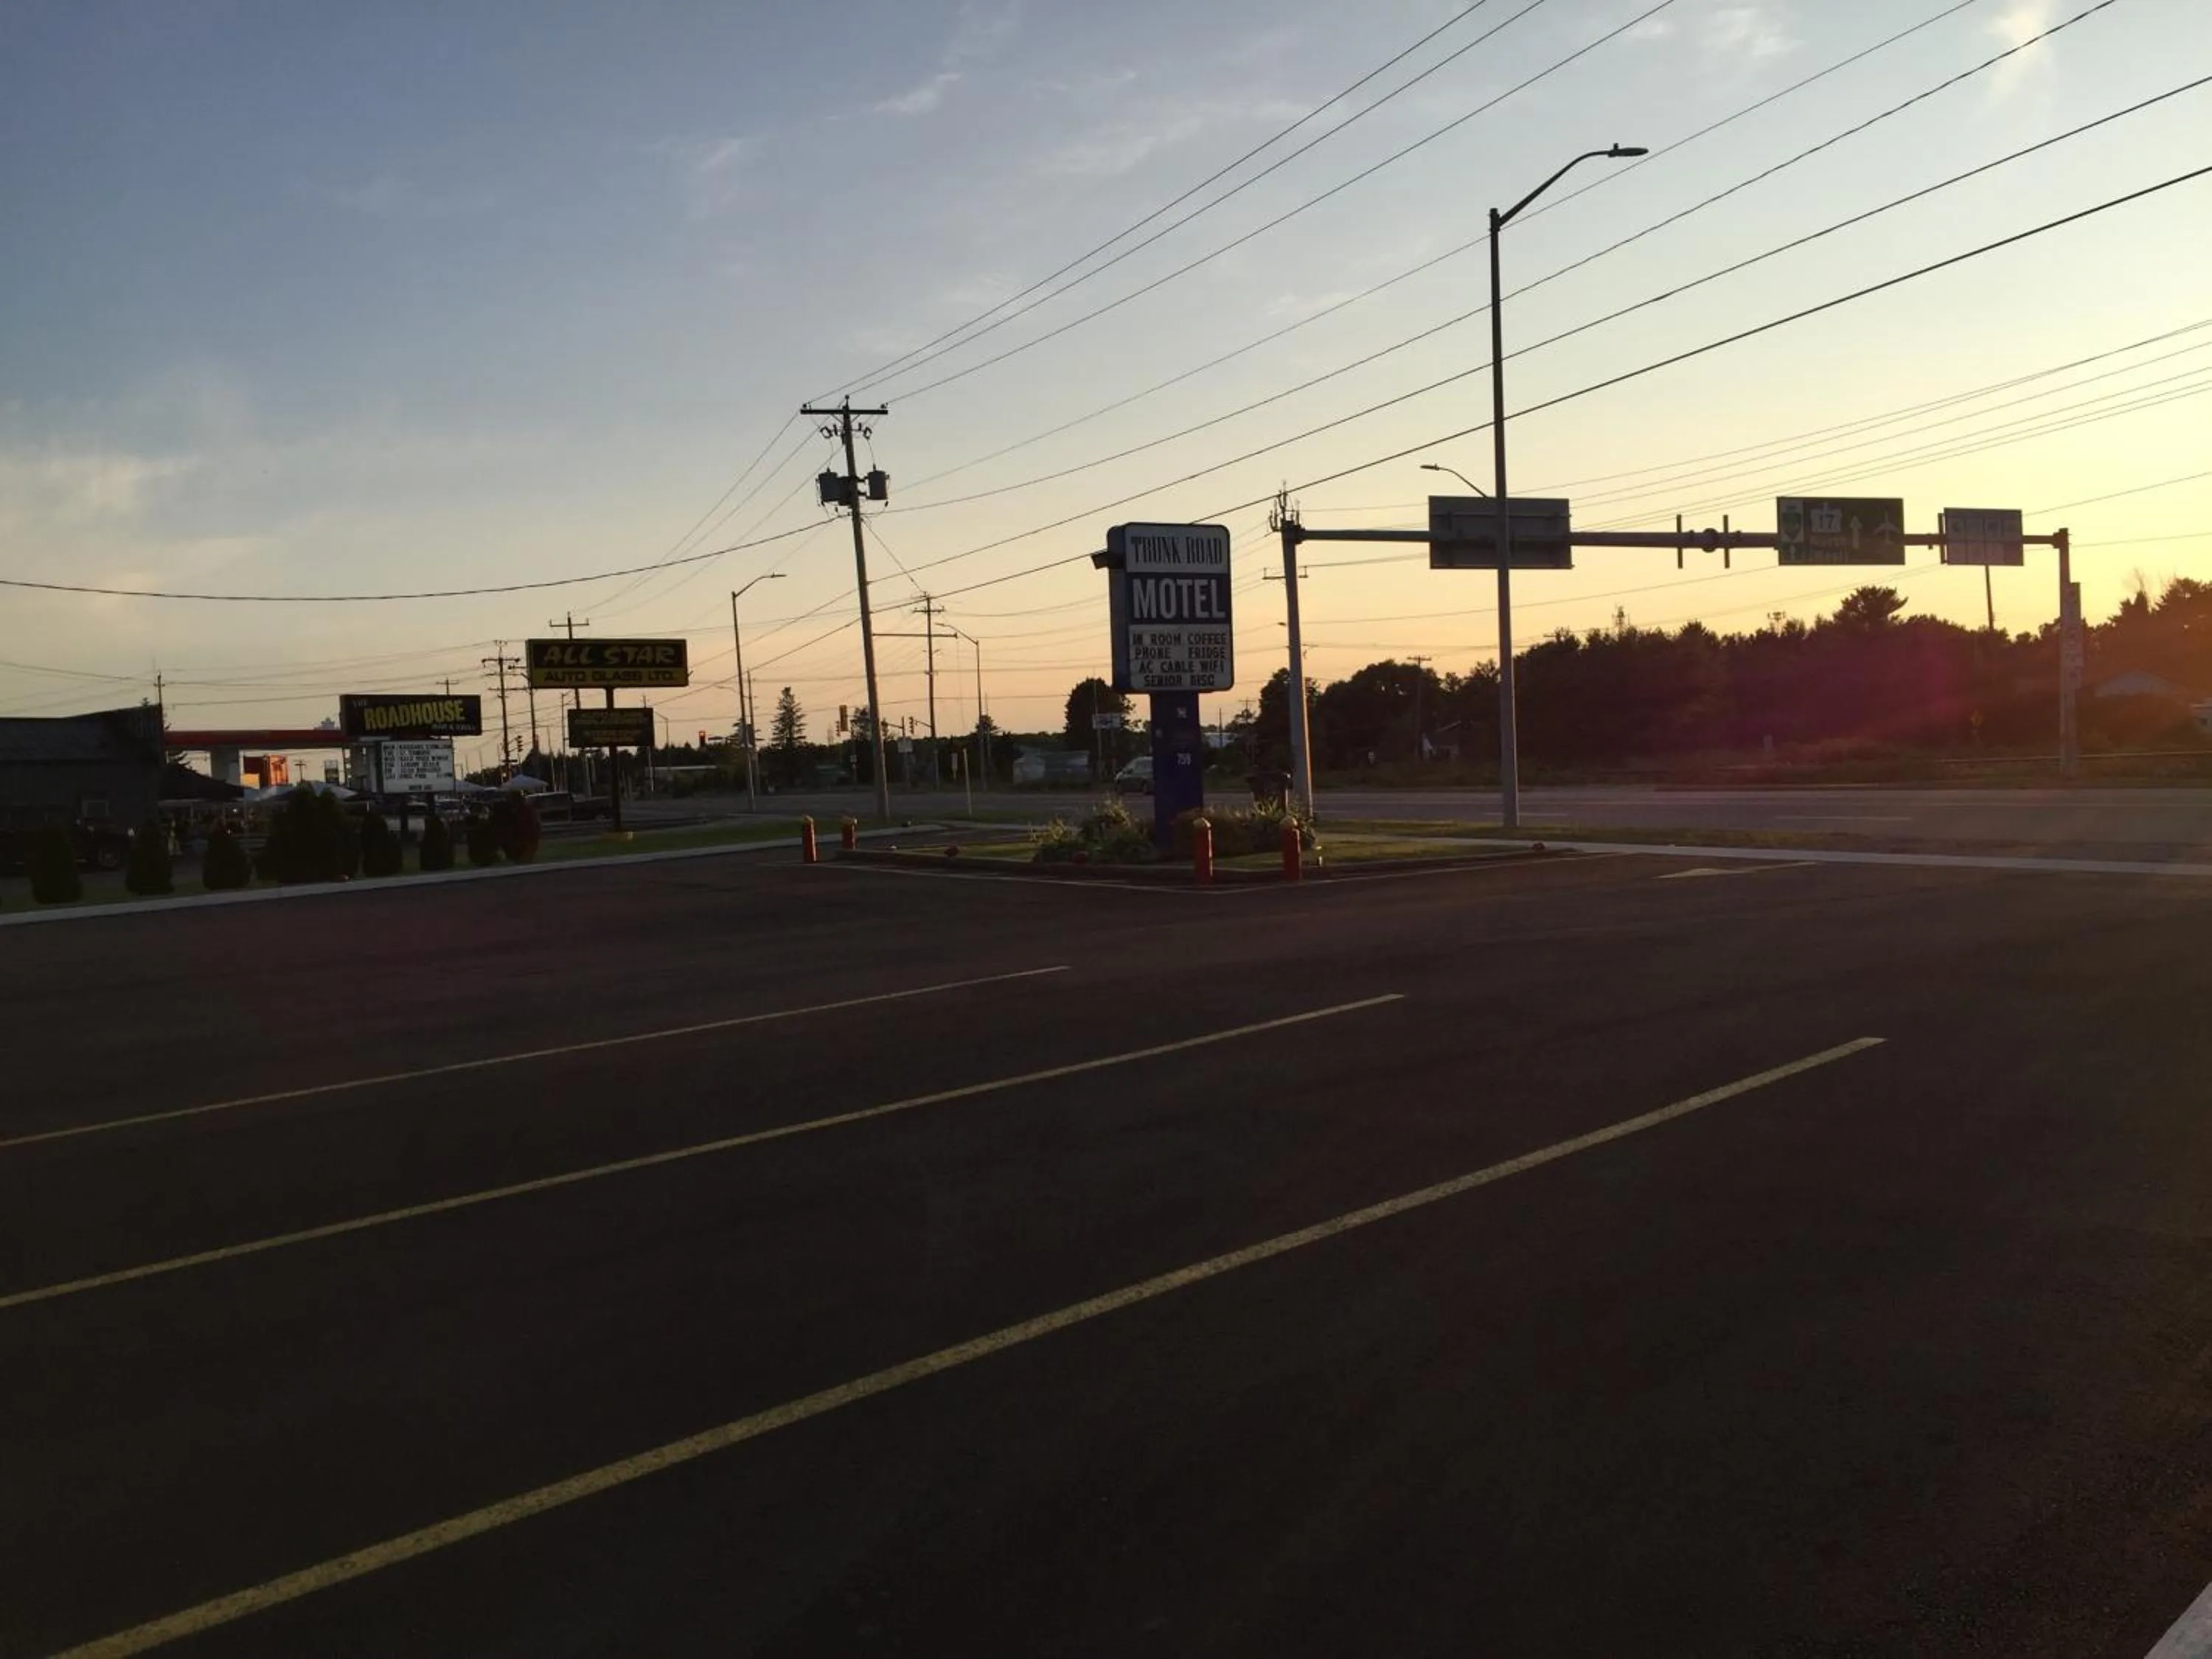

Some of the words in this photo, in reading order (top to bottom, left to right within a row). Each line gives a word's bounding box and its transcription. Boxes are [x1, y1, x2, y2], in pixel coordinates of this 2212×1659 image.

[1131, 536, 1182, 564] TRUNK
[1186, 536, 1222, 564] ROAD
[1132, 578, 1226, 619] MOTEL
[1150, 633, 1180, 645] ROOM
[1188, 633, 1226, 644] COFFEE
[543, 645, 594, 664] ALL
[603, 645, 675, 664] STAR
[1135, 647, 1172, 659] PHONE
[1188, 647, 1226, 658] FRIDGE
[1138, 661, 1154, 672] AC
[1160, 661, 1194, 672] CABLE
[544, 670, 586, 682] AUTO
[591, 670, 641, 682] GLASS
[1144, 675, 1182, 687] SENIOR
[364, 699, 466, 731] ROADHOUSE
